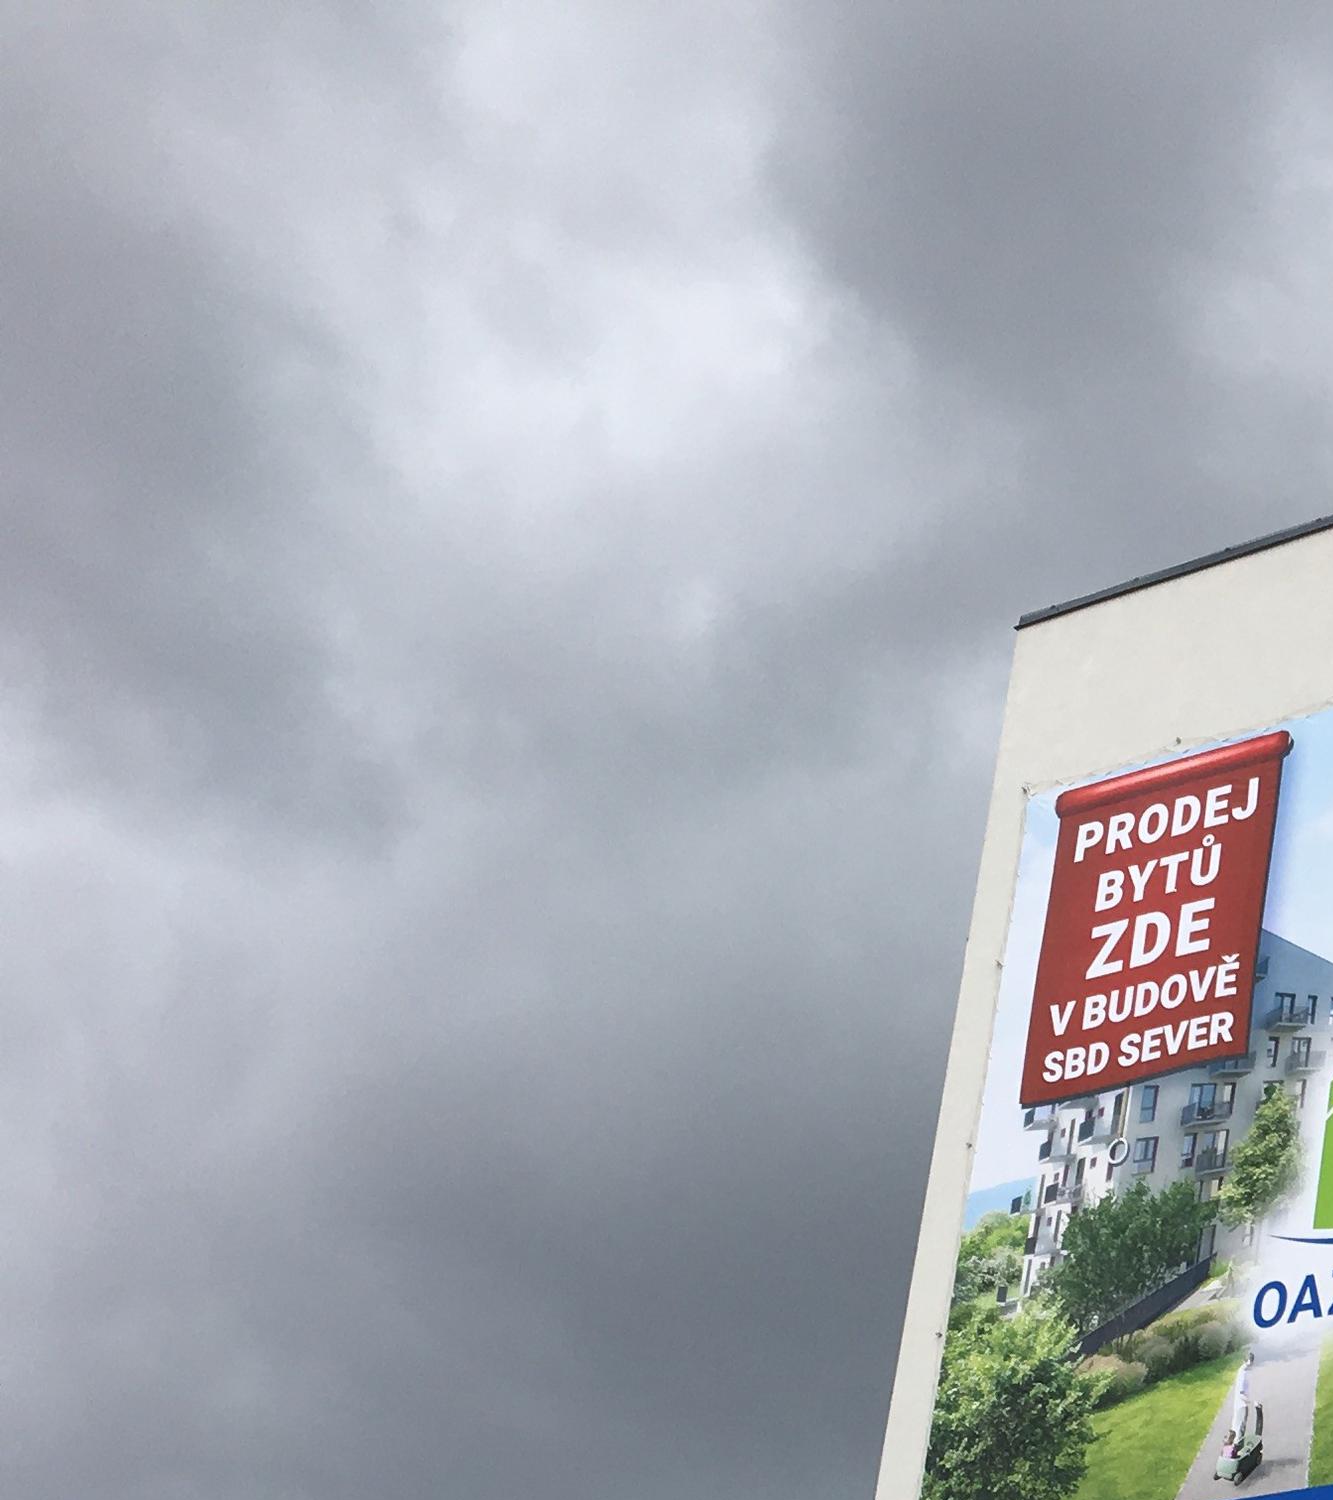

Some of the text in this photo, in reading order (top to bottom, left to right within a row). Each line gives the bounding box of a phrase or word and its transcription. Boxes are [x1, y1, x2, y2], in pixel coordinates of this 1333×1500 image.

[1073, 777, 1260, 863] PRODEJ
[1094, 834, 1222, 913] BYTŮ
[1085, 897, 1216, 980] ZDE
[1050, 953, 1240, 1037] V BUDOVĚ
[1042, 1011, 1235, 1083] SBD SEVER
